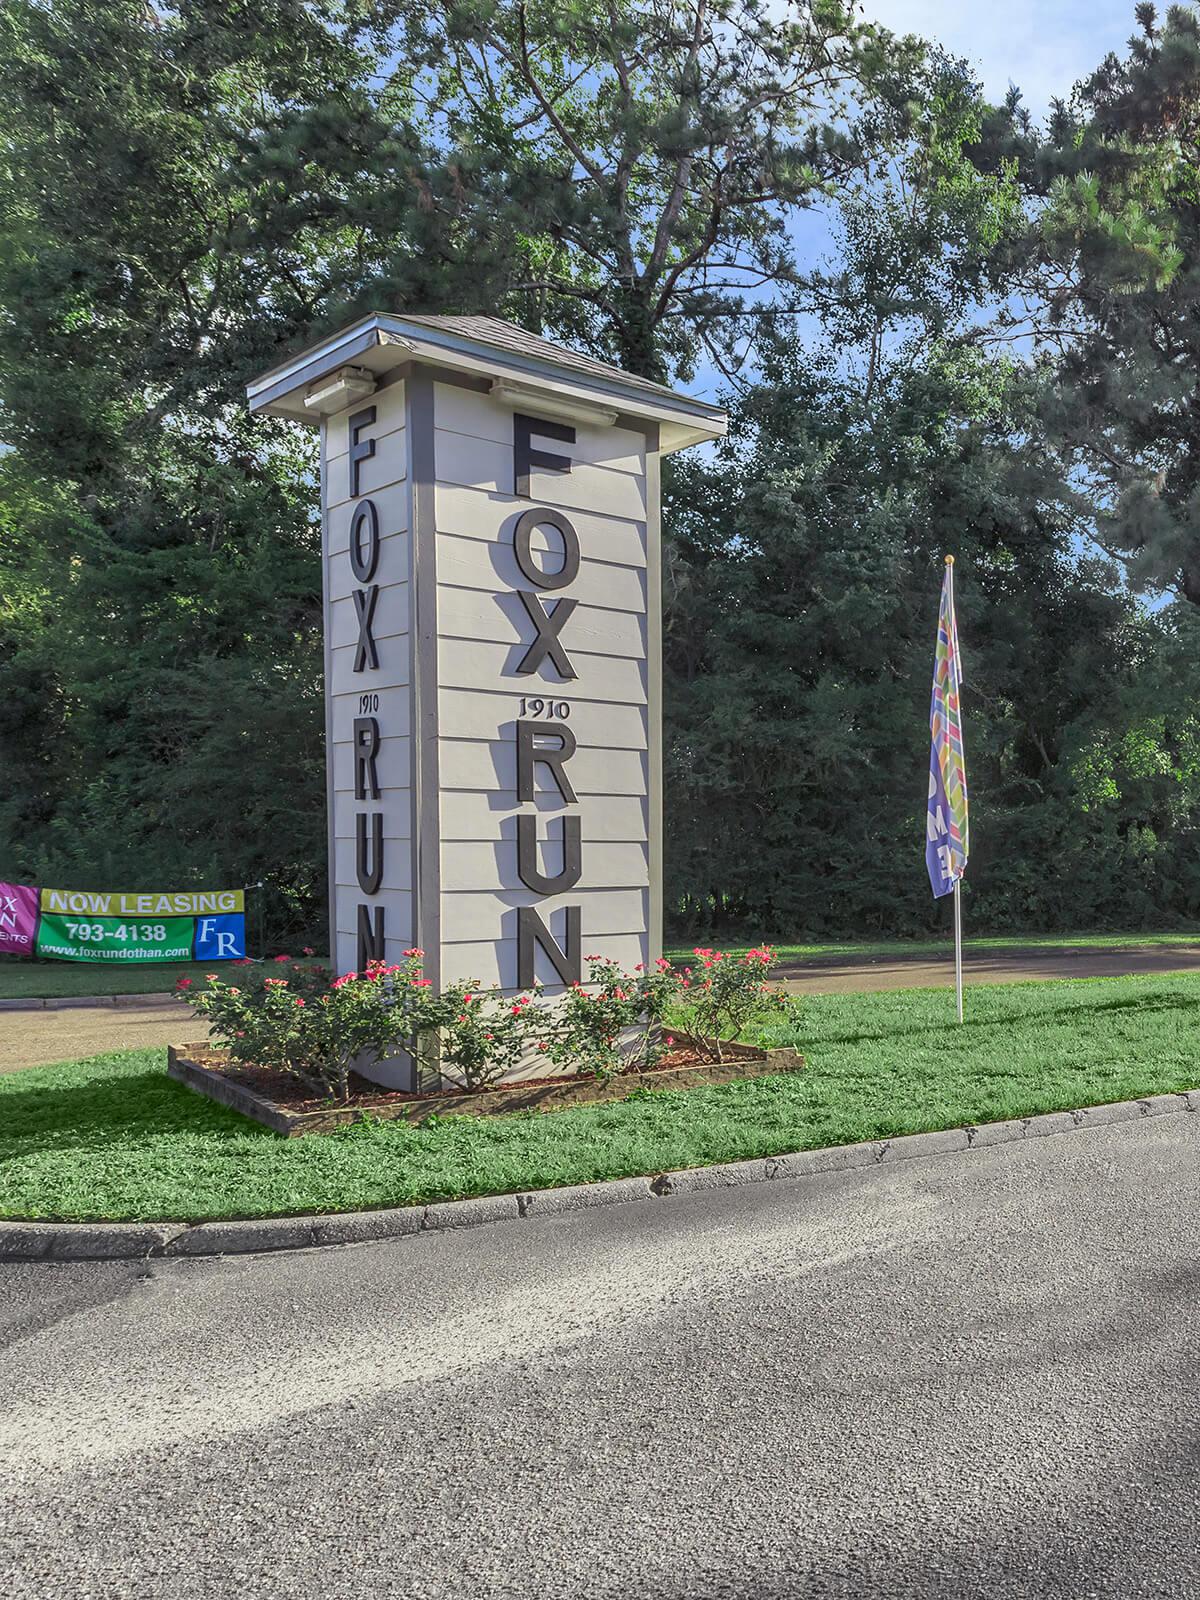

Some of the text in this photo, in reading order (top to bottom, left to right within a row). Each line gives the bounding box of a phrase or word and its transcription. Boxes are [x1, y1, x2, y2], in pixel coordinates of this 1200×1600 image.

[349, 407, 378, 673] FOX
[513, 413, 581, 680] FOX
[358, 694, 380, 715] 1910
[518, 697, 571, 720] 1910
[354, 717, 385, 978] RUN
[516, 720, 582, 990] RUN
[49, 893, 236, 913] NOW LEASING
[65, 924, 167, 941] 793-4138
[40, 944, 189, 958] www.foxrundothan.com
